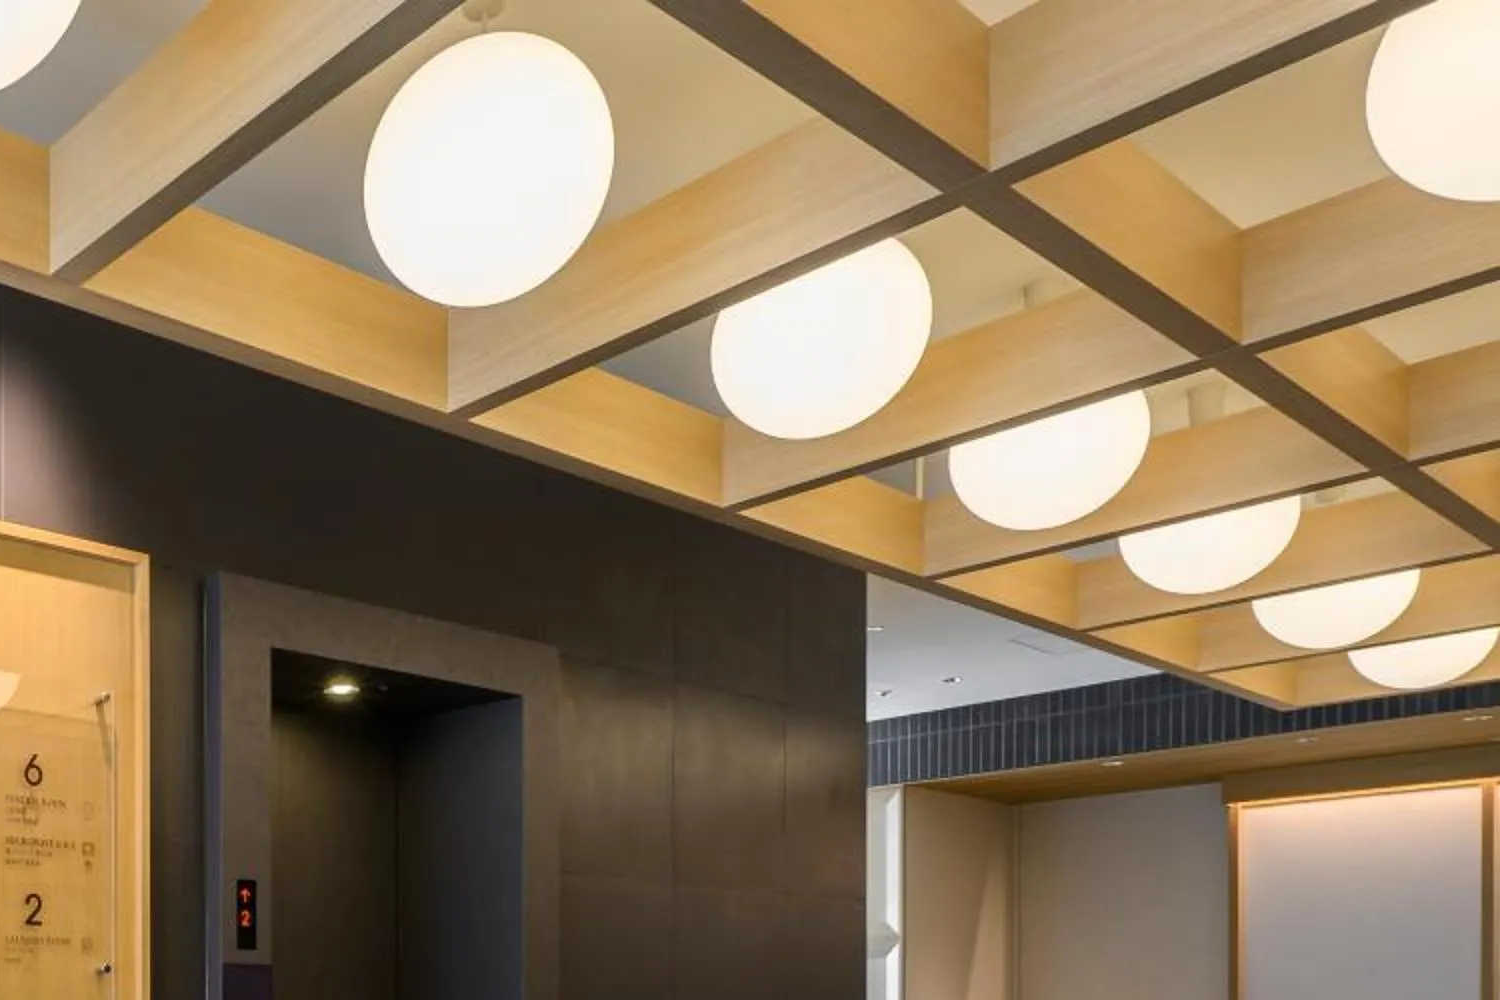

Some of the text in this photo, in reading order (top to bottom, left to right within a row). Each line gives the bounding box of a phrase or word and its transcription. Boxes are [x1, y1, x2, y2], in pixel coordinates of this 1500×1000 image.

[23, 753, 43, 787] 6
[23, 892, 44, 927] 2
[241, 910, 251, 926] 2
